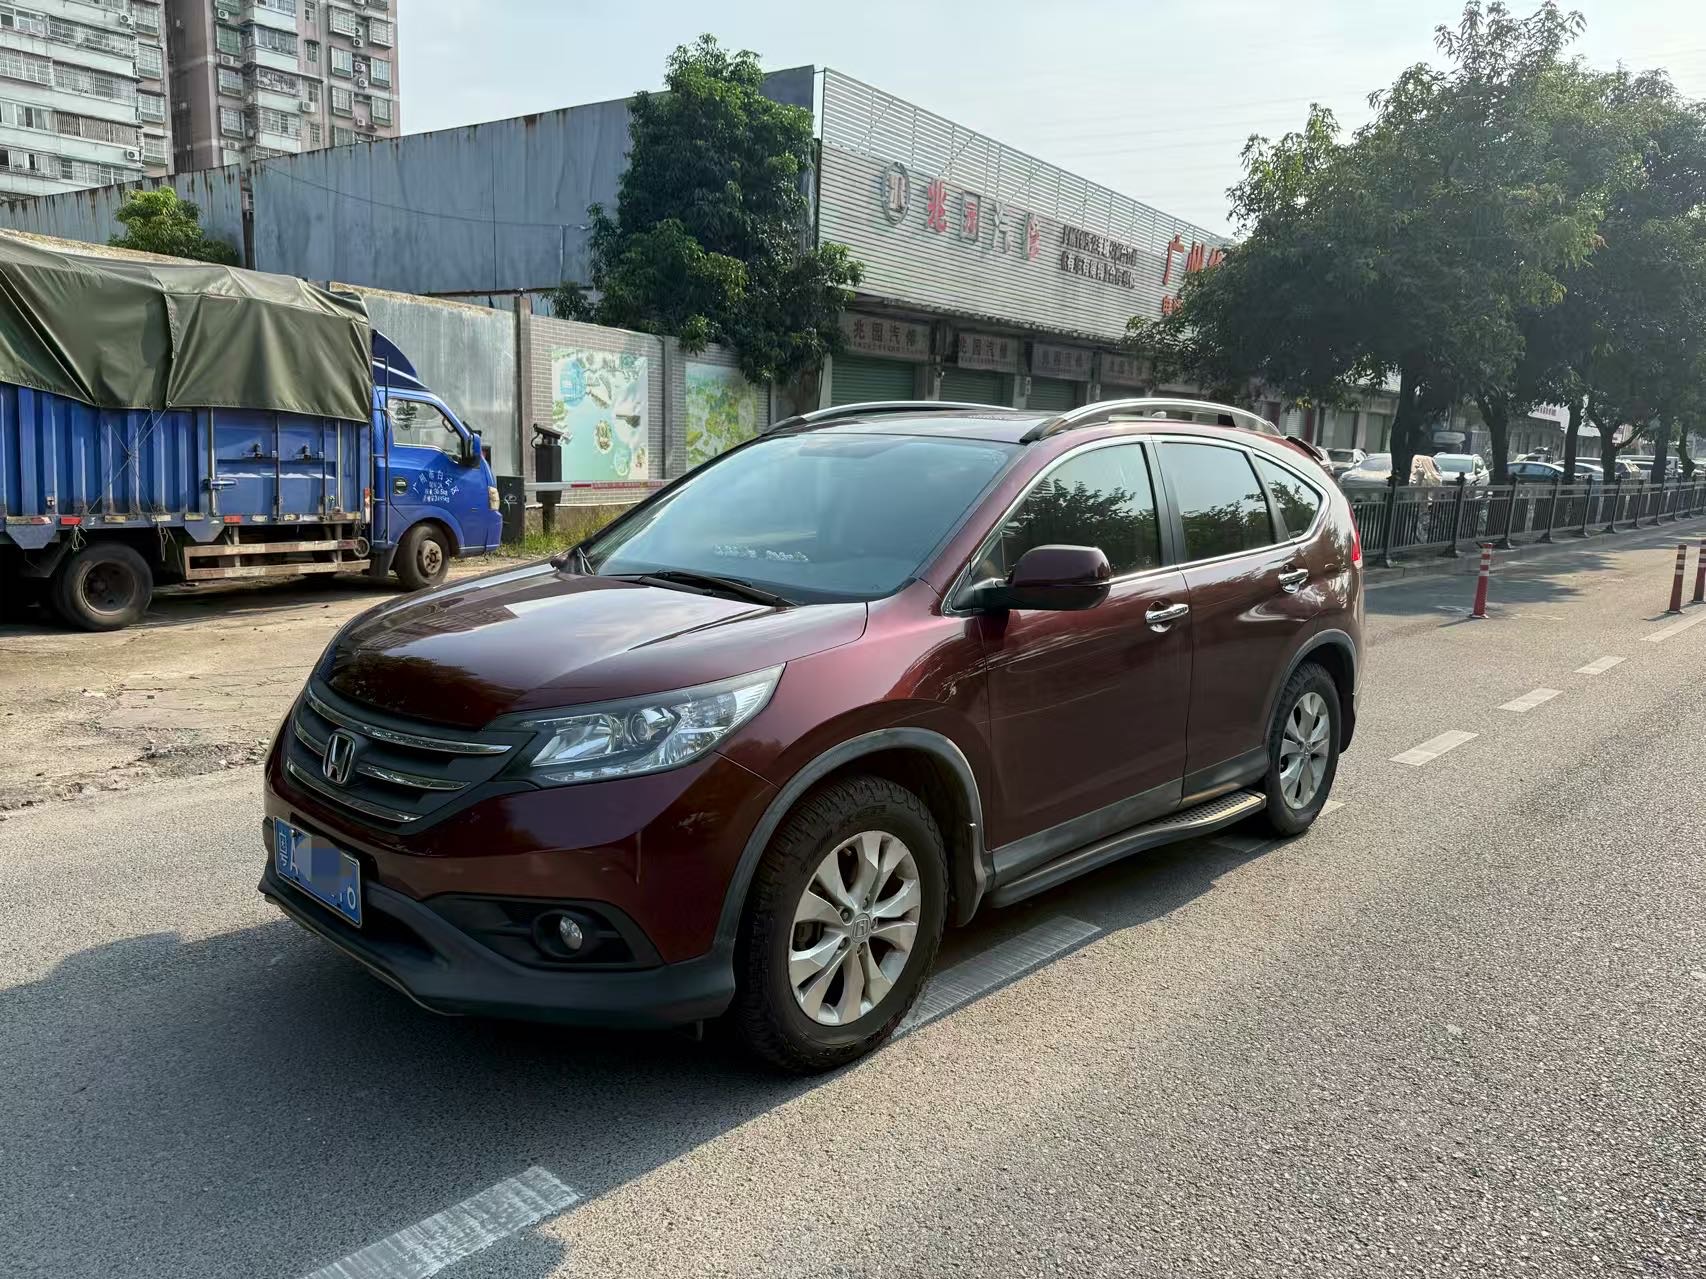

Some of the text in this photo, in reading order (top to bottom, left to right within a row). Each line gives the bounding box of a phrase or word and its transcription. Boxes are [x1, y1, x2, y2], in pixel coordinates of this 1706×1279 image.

[411, 469, 460, 496] 广州市白云区
